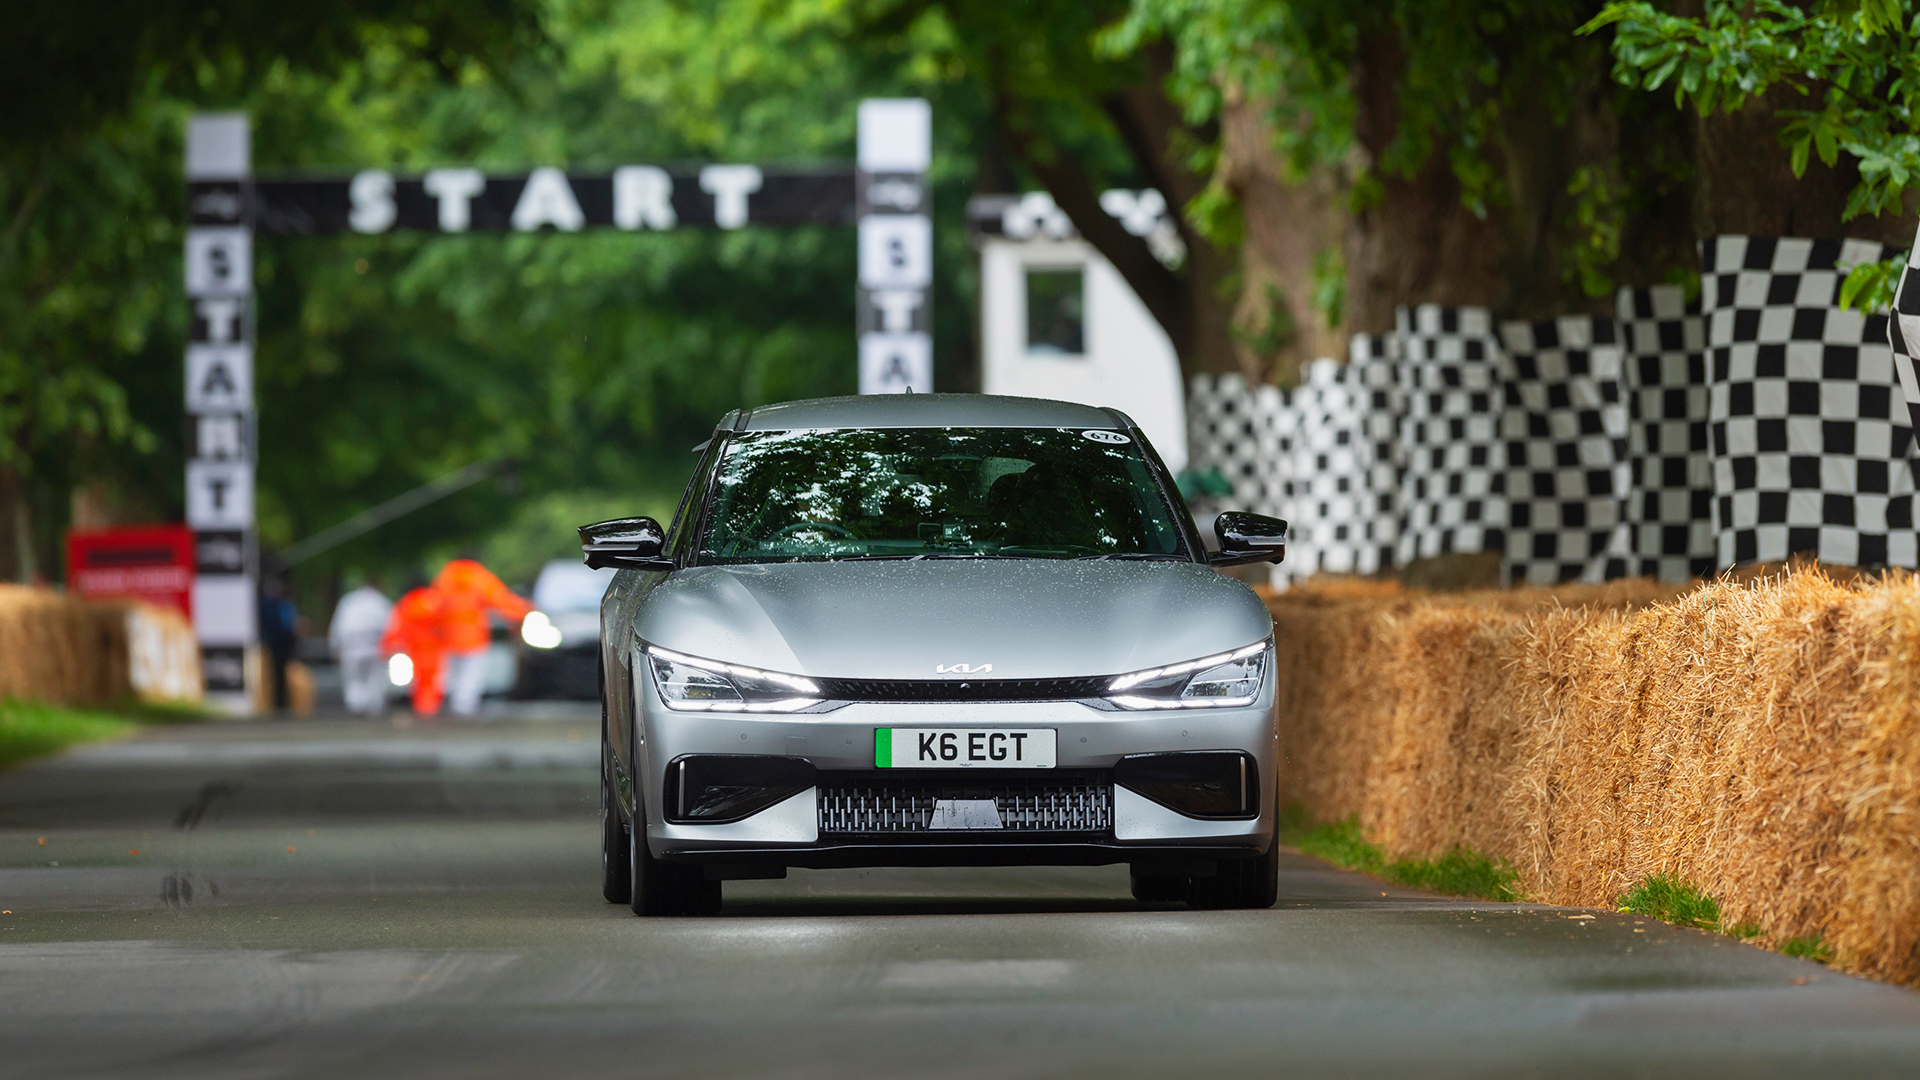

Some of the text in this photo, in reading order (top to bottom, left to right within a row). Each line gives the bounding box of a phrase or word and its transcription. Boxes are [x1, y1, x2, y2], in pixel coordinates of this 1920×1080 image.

[348, 164, 764, 234] START
[196, 244, 242, 510] START
[1090, 432, 1123, 441] 676
[936, 663, 993, 674] KIA
[918, 732, 1028, 761] K6 EGT
